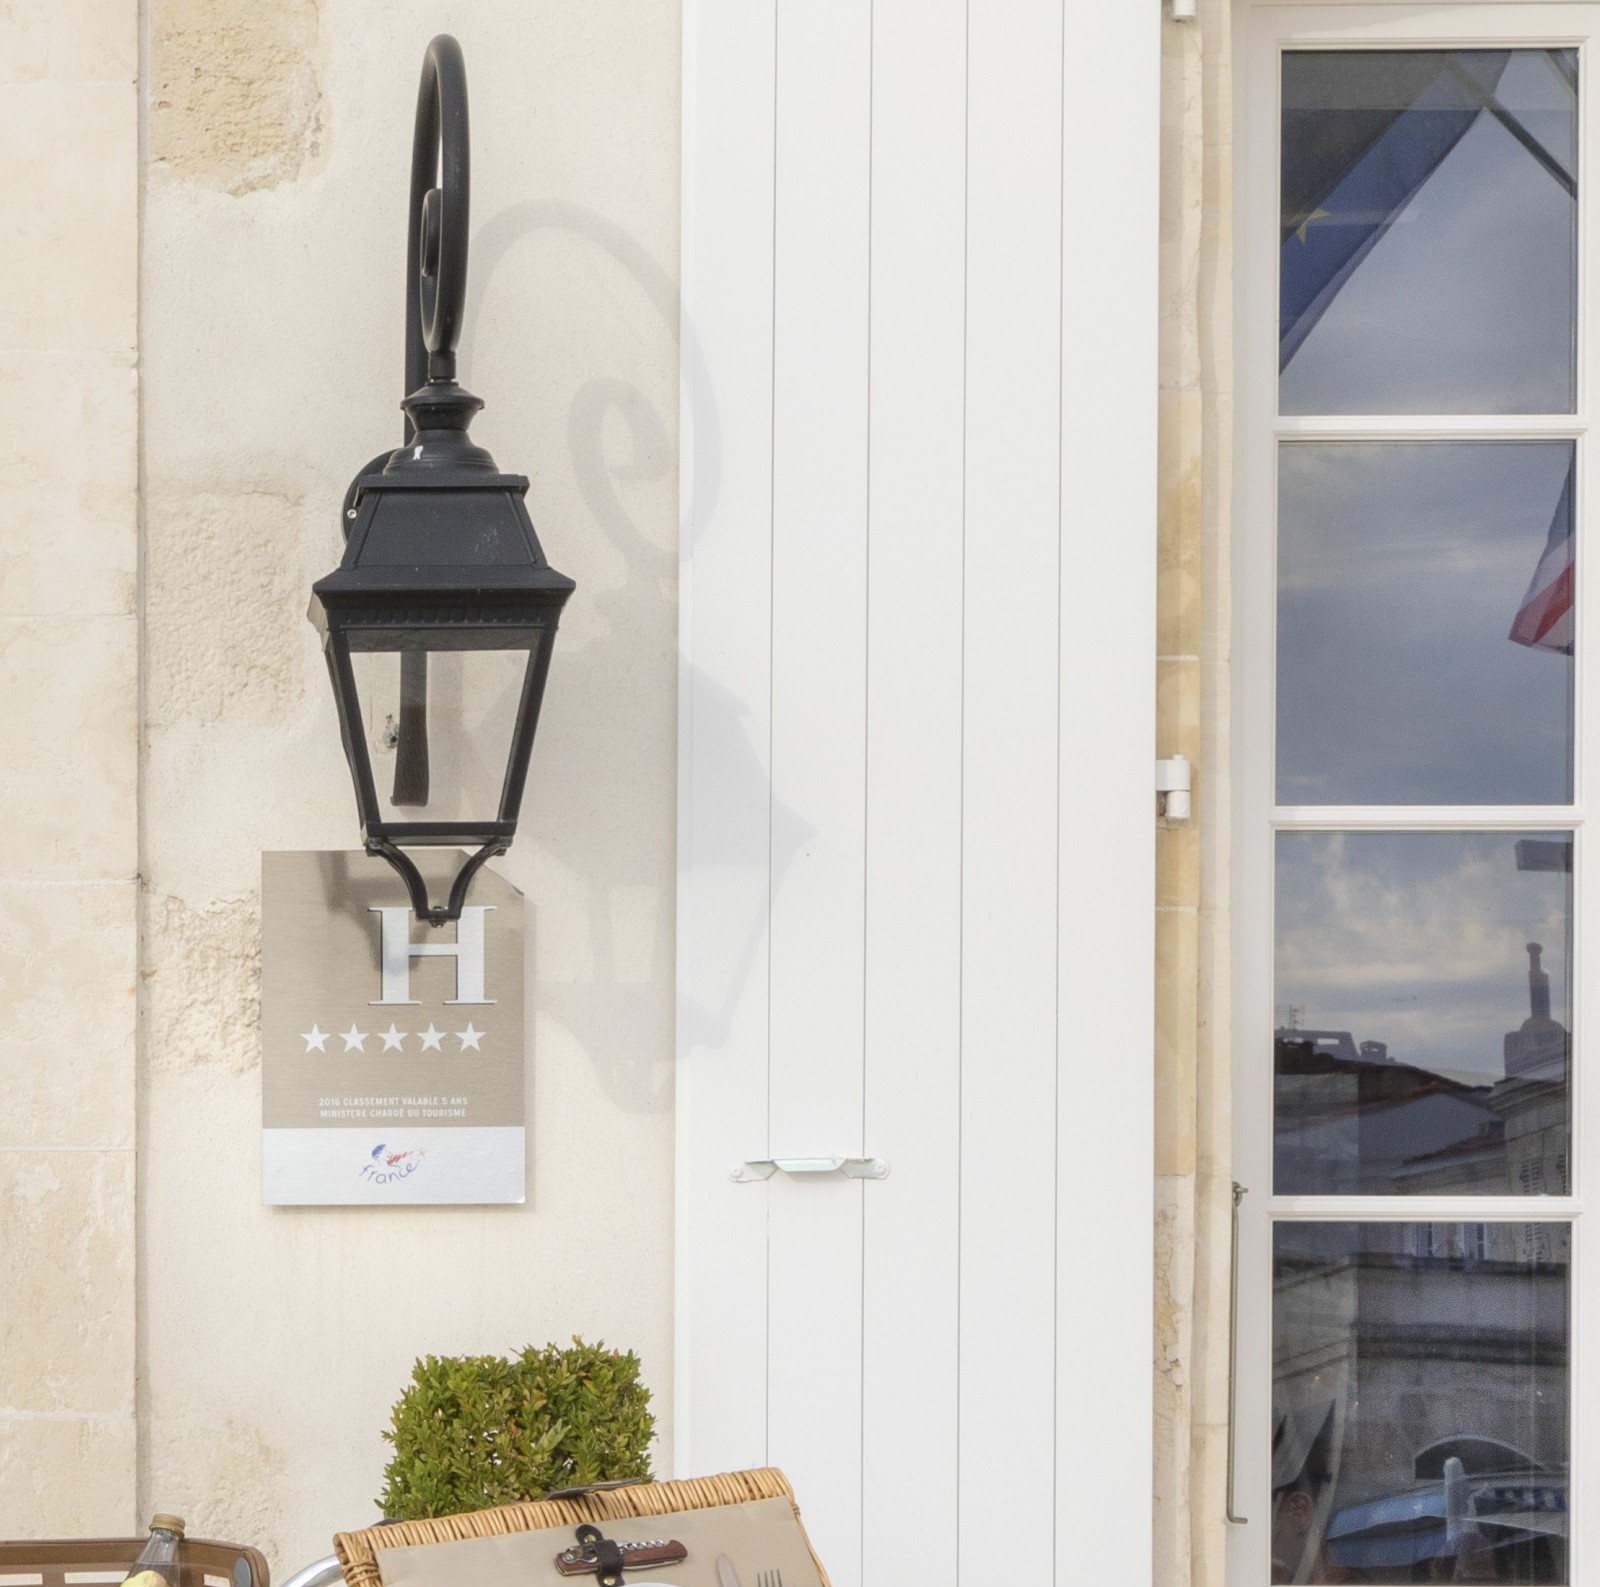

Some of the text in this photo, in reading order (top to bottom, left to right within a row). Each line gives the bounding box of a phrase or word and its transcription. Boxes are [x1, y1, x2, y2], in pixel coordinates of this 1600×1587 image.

[367, 904, 497, 1005] H
[318, 1096, 469, 1107] 2016 CLASSEMENT VALABLE 5 ANS
[407, 1109, 420, 1118] DU
[422, 1108, 467, 1118] TOURISME
